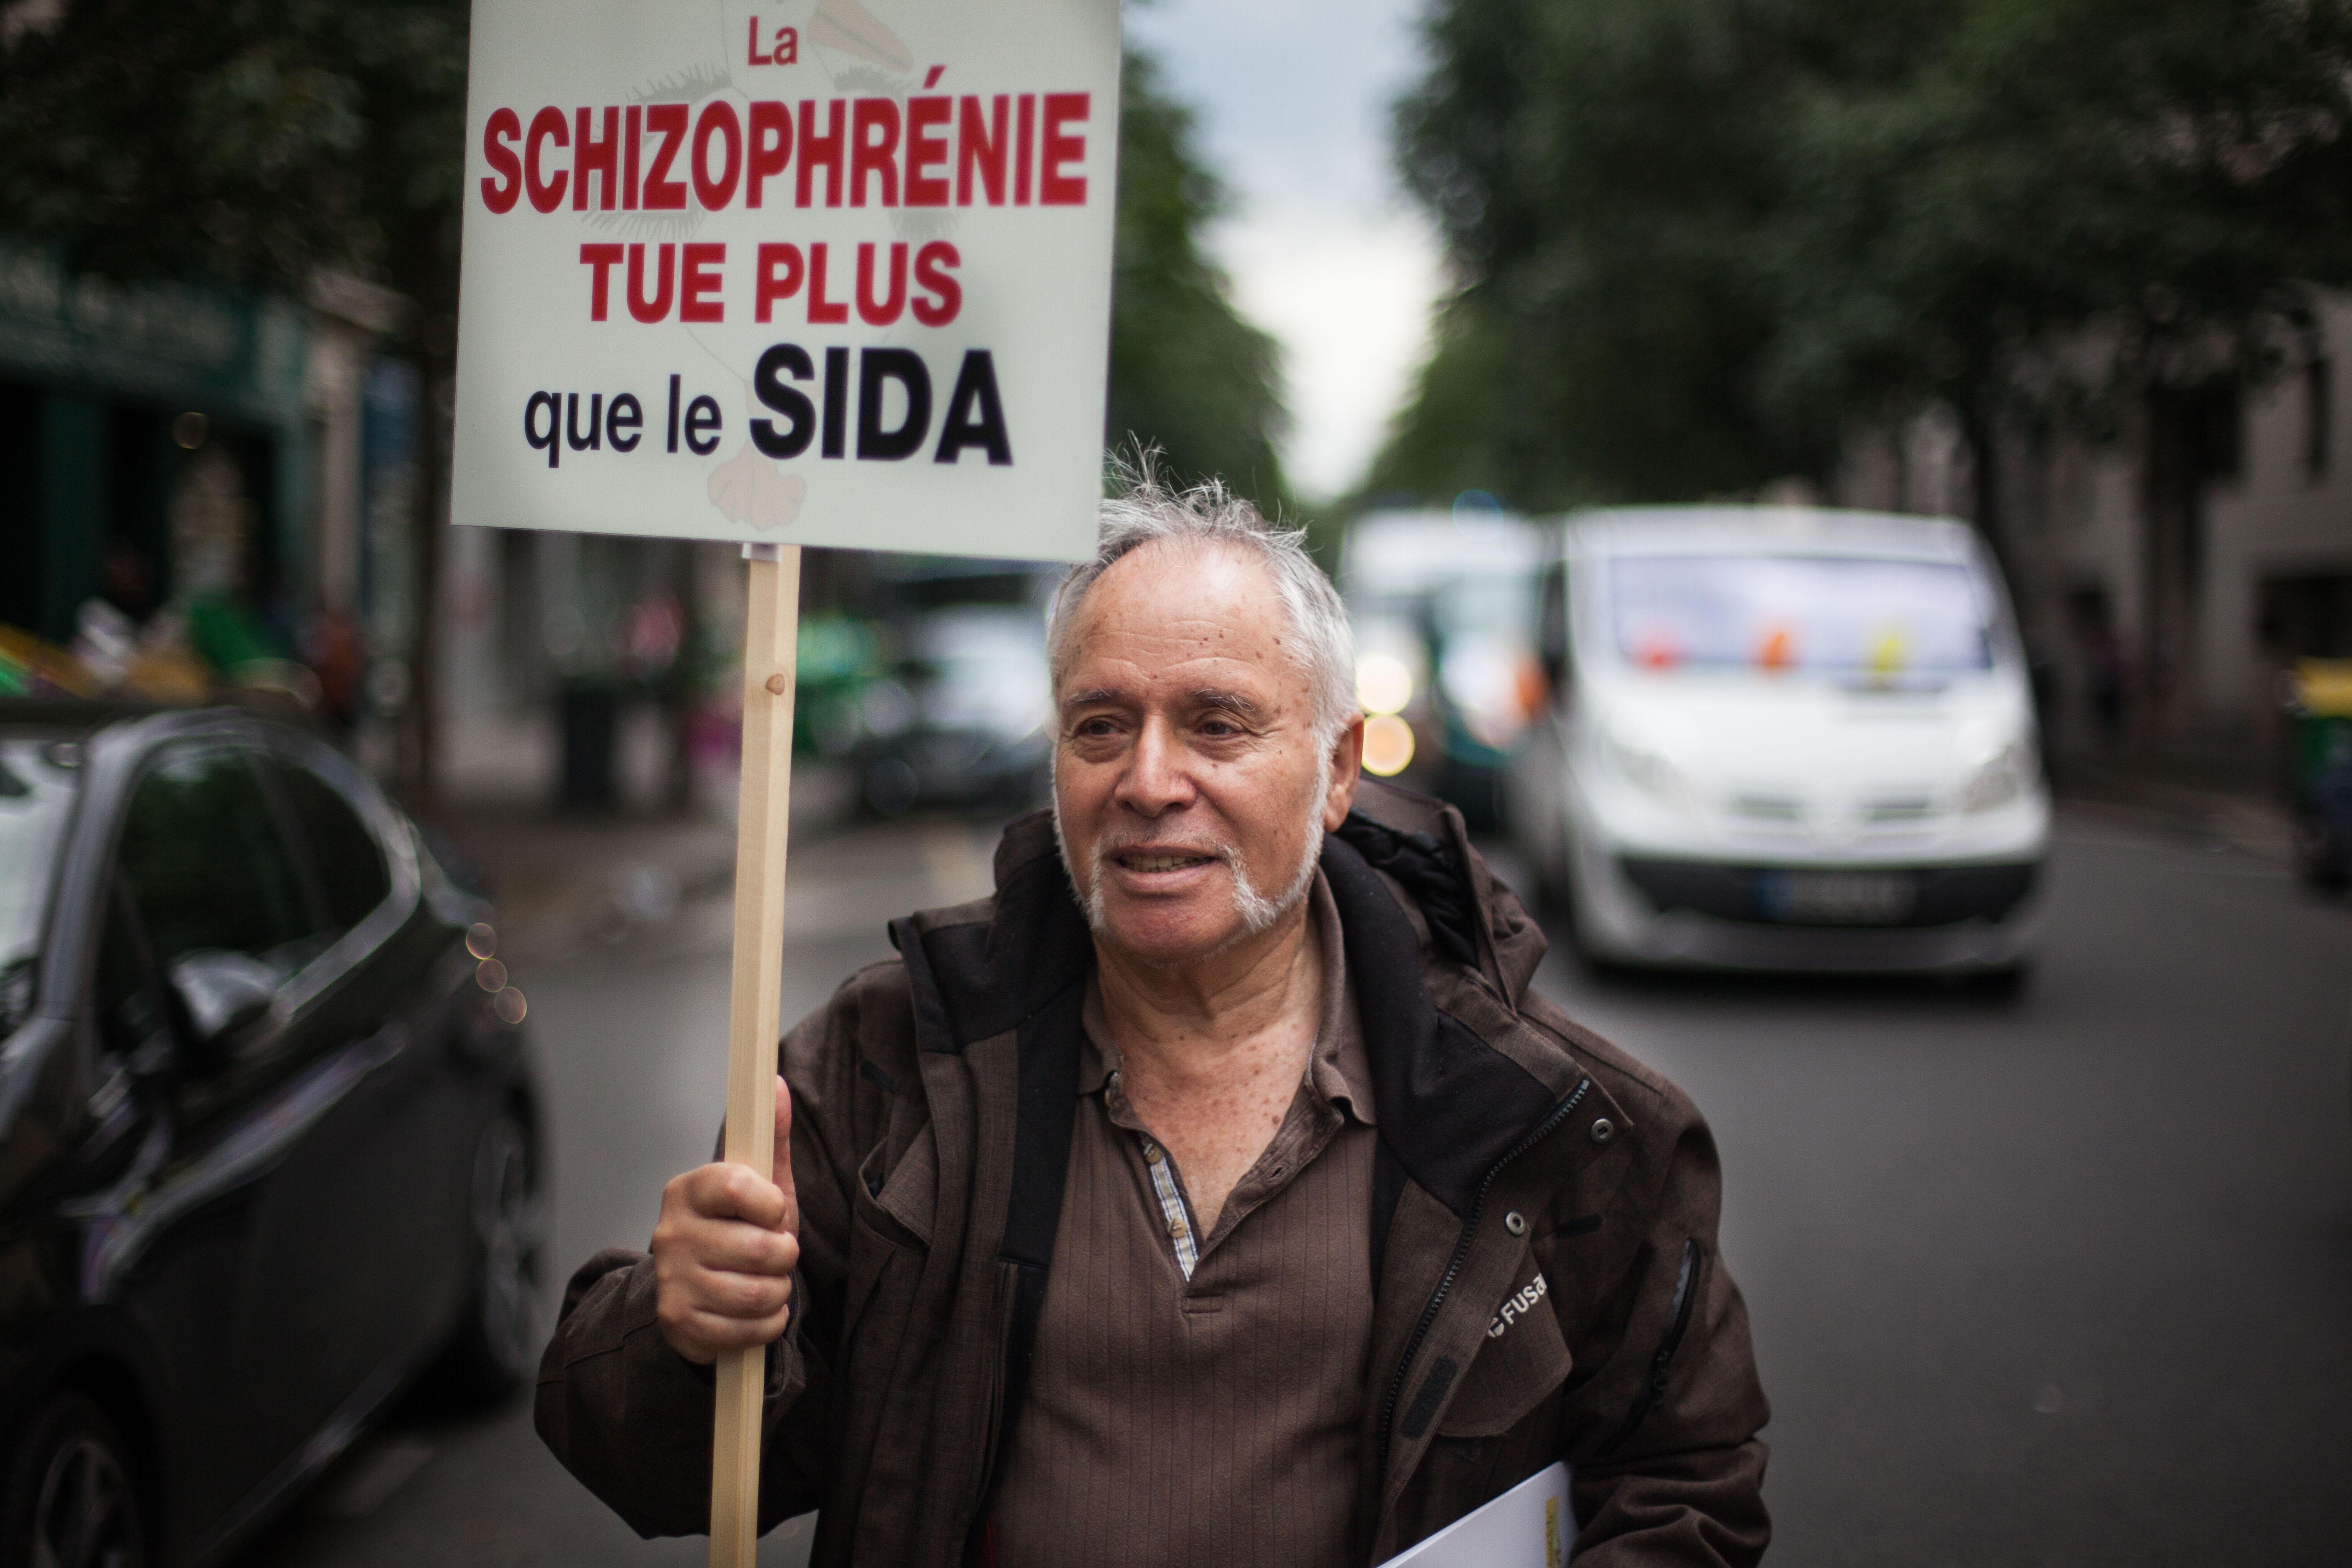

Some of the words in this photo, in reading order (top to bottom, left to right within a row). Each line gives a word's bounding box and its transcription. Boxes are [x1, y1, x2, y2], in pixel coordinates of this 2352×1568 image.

[747, 16, 798, 65] La
[481, 65, 1091, 214] SCHIZOPHRÉNIE
[580, 242, 726, 324] TUE
[754, 240, 962, 327] PLUS
[524, 389, 644, 469] que
[666, 374, 723, 456] le
[749, 343, 1013, 466] SIDA
